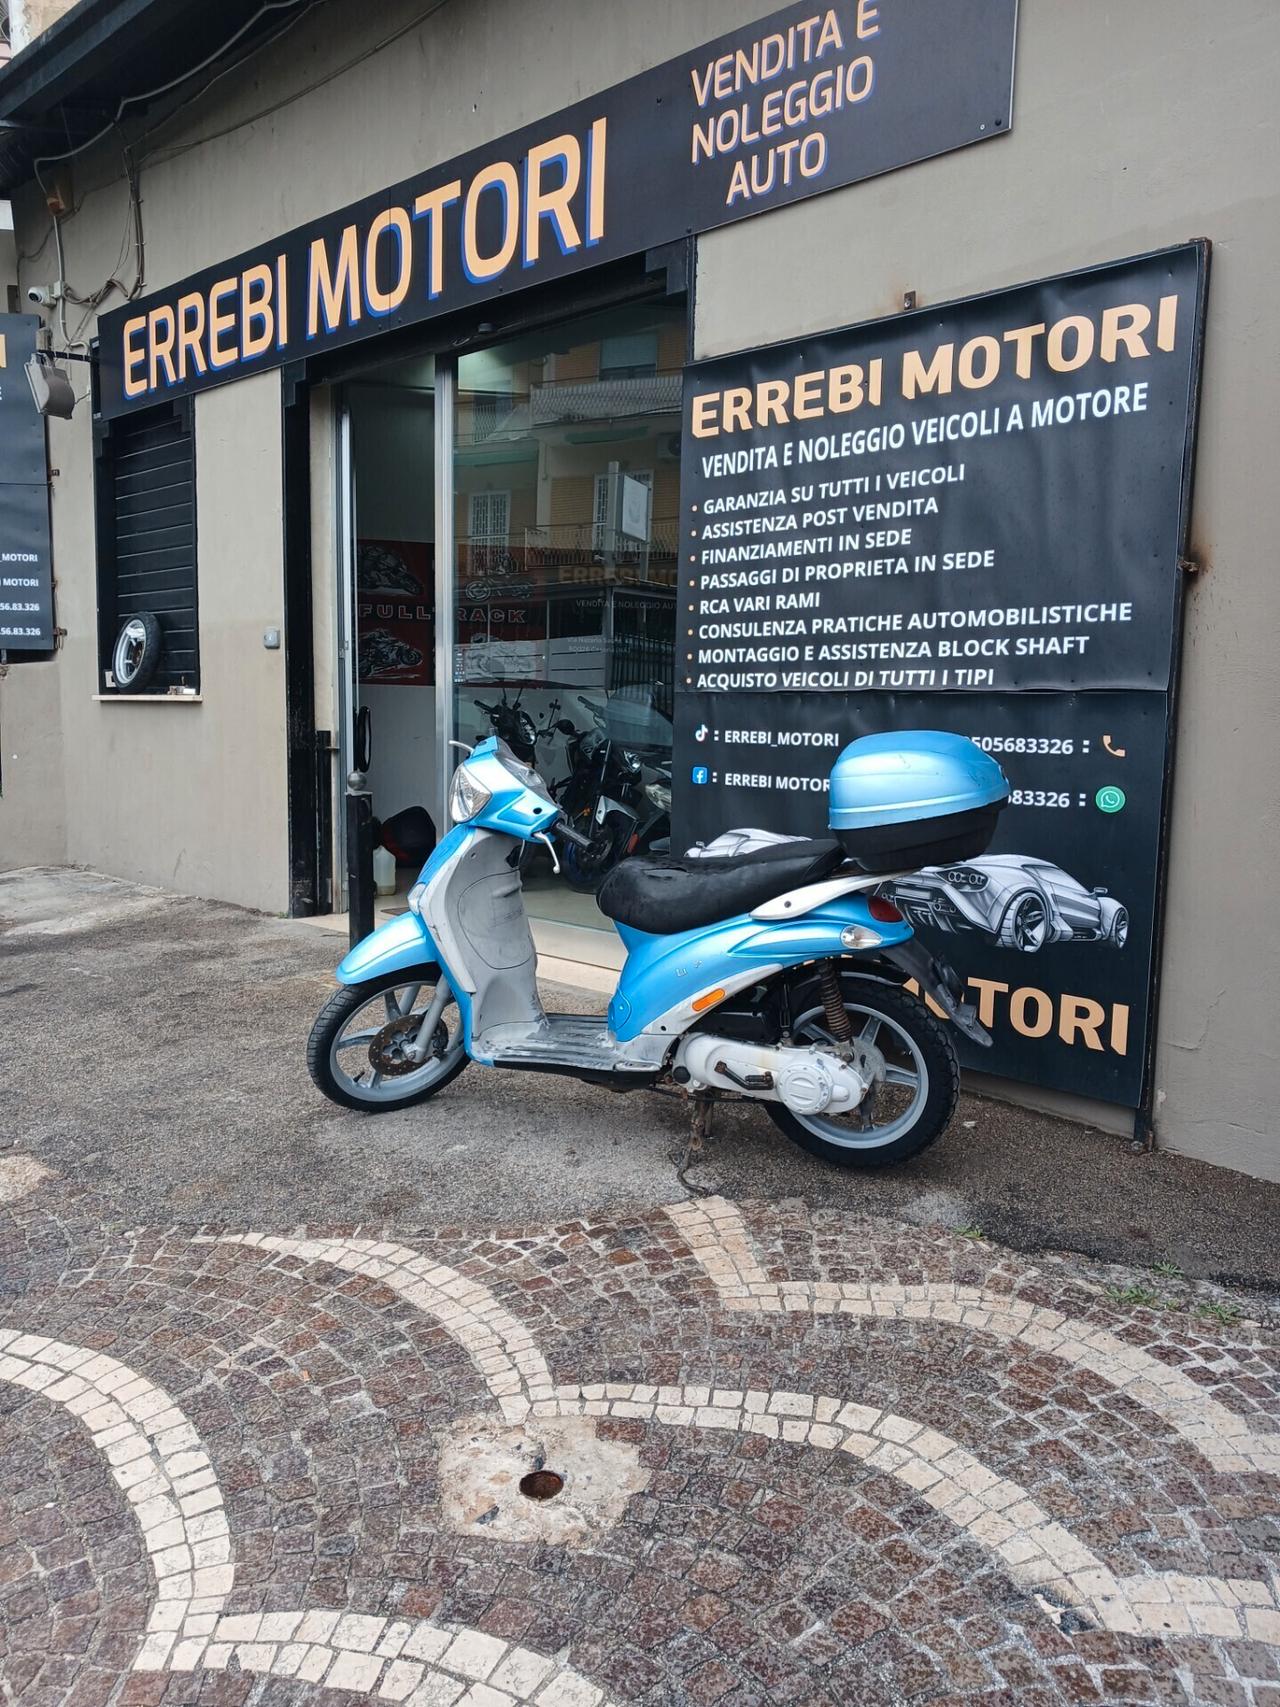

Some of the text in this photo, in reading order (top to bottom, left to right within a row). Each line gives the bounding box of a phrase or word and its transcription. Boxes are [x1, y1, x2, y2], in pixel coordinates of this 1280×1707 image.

[691, 0, 880, 108] VENDITA E
[691, 55, 874, 165] NOLEGGIO
[725, 132, 827, 206] AUTO
[122, 117, 607, 400] ERREBI MOTORI
[691, 294, 1178, 439] ERREBI MOTORI
[702, 382, 1149, 478] VENDITA E NOLEGGIO VEICOLI A MOTORE
[703, 463, 965, 515] GARANZIA SU TUTTI I VEICOLI
[701, 497, 939, 540] ASSISTENZA POST VENDITA
[701, 528, 912, 565] FINANZIAMENTI IN SEDE
[2, 578, 39, 587] MOTORI
[700, 569, 777, 590] PASSAGGI
[782, 565, 800, 584] DI
[804, 557, 909, 582] PROPRIETA
[914, 554, 937, 573] IN
[942, 549, 996, 571] SEDE
[699, 592, 821, 615] RCA VARI RAMI
[699, 602, 1133, 640] CONSULENZA PRATICHE AUTOMOBILISTICHE
[698, 636, 1090, 664] MONTAGGIO E ASSISTENZA BLOCK SHAFT
[697, 669, 994, 691] ACQUISTO VEICOLI DI TUTTI I TIPI
[724, 730, 839, 747] ERREBI_MOTORI
[968, 736, 1074, 755] 505683326
[724, 773, 772, 788] ERREBI
[775, 776, 830, 792] MOTOR
